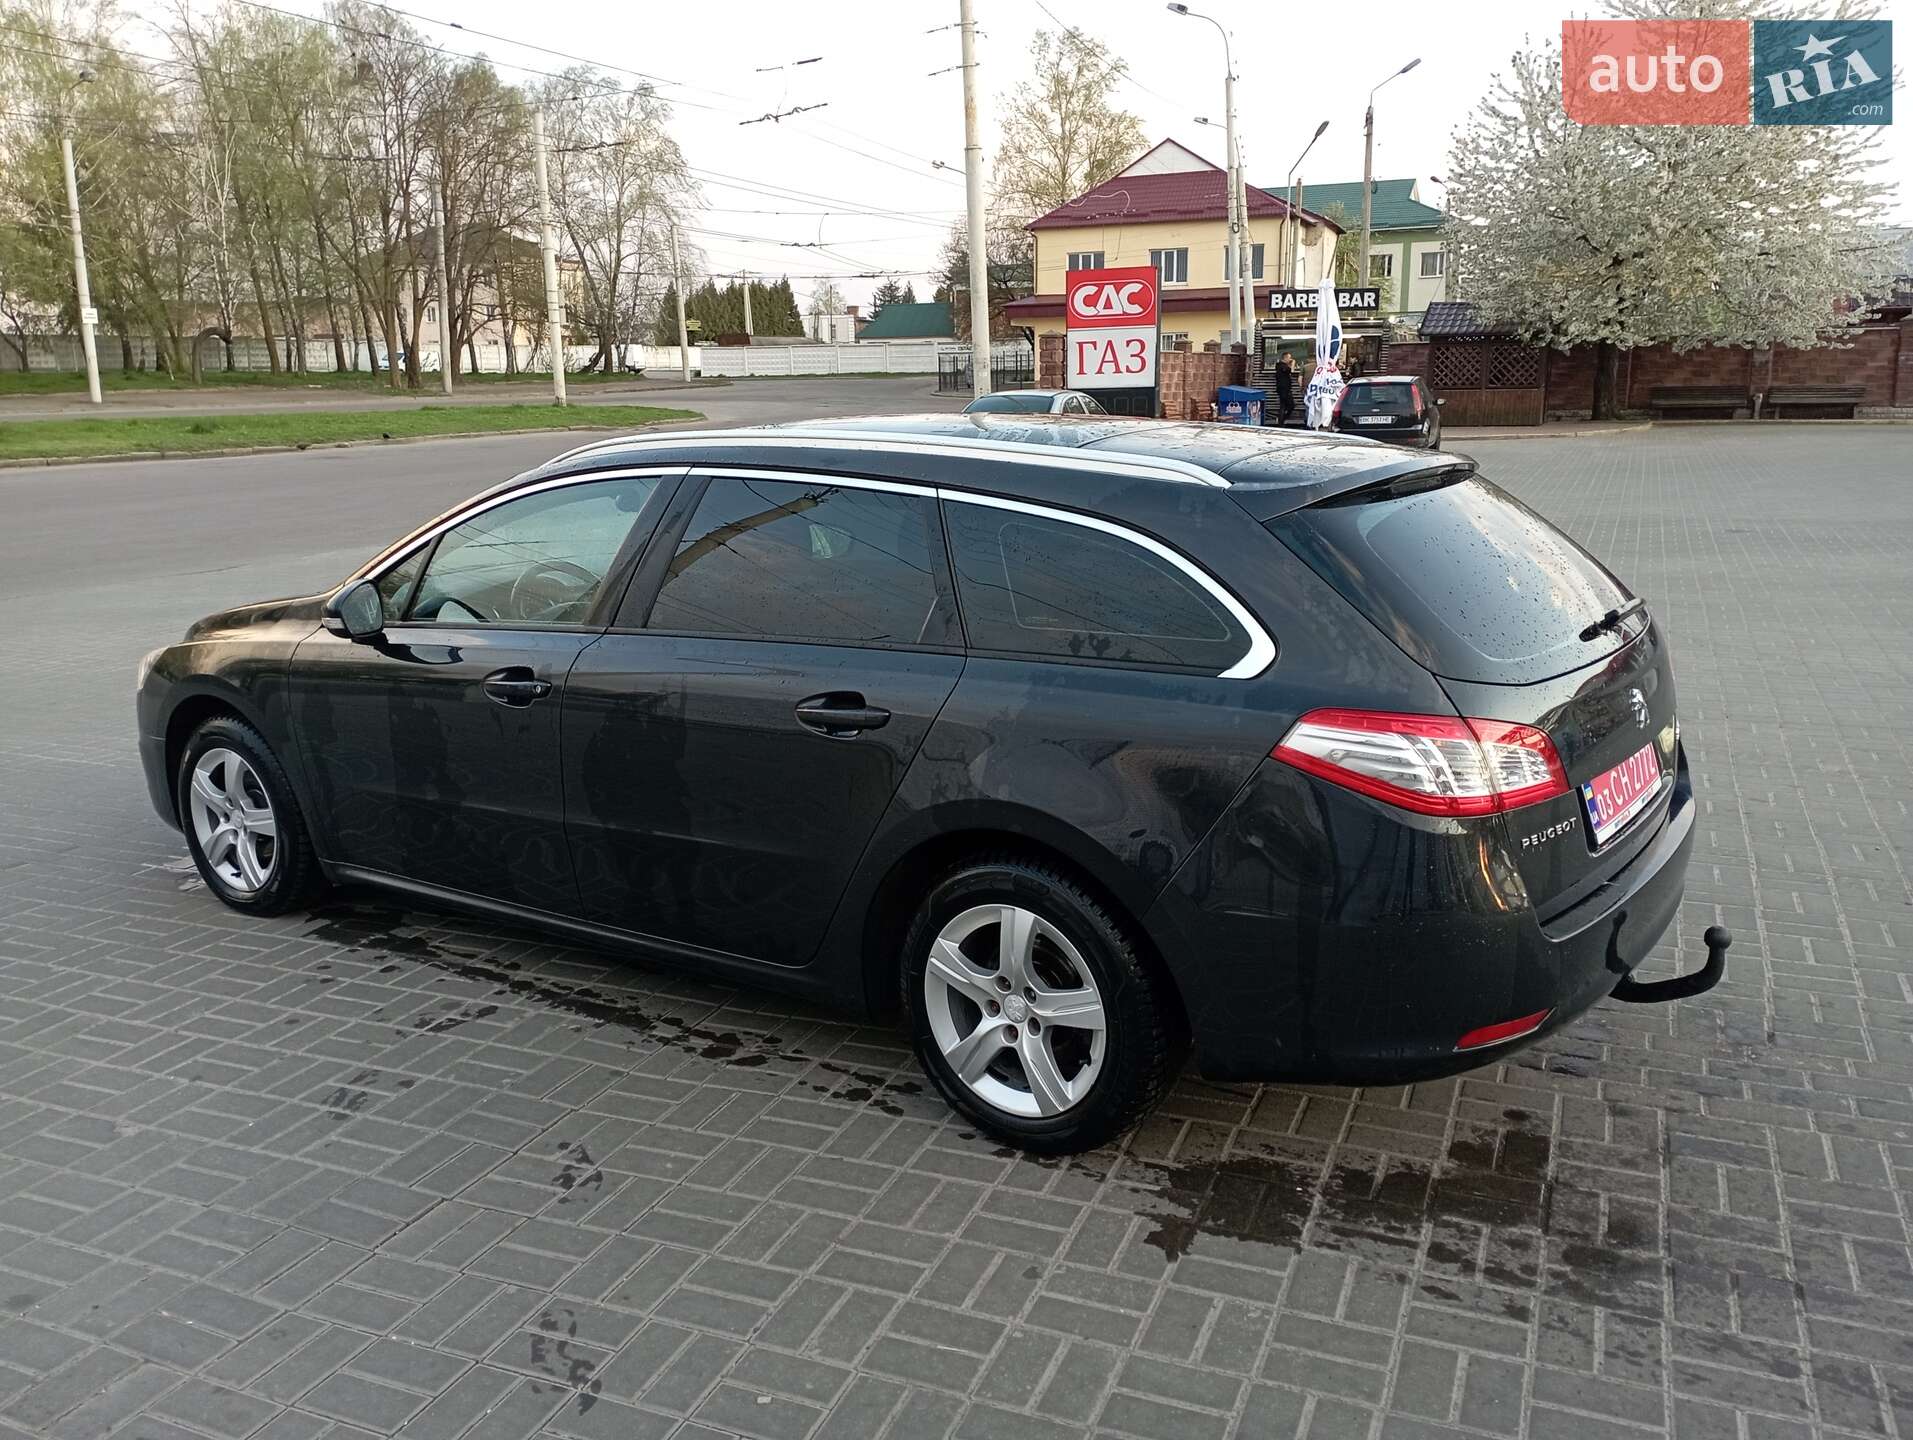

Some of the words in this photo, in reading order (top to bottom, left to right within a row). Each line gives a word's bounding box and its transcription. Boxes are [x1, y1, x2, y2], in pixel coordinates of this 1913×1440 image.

[1338, 292, 1376, 308] BAR
[1075, 339, 1147, 376] ГАЗ
[1597, 788, 1614, 820] 03
[1610, 762, 1632, 806] CH
[1629, 742, 1656, 791] 2772
[1521, 817, 1577, 850] PEUGEOT
